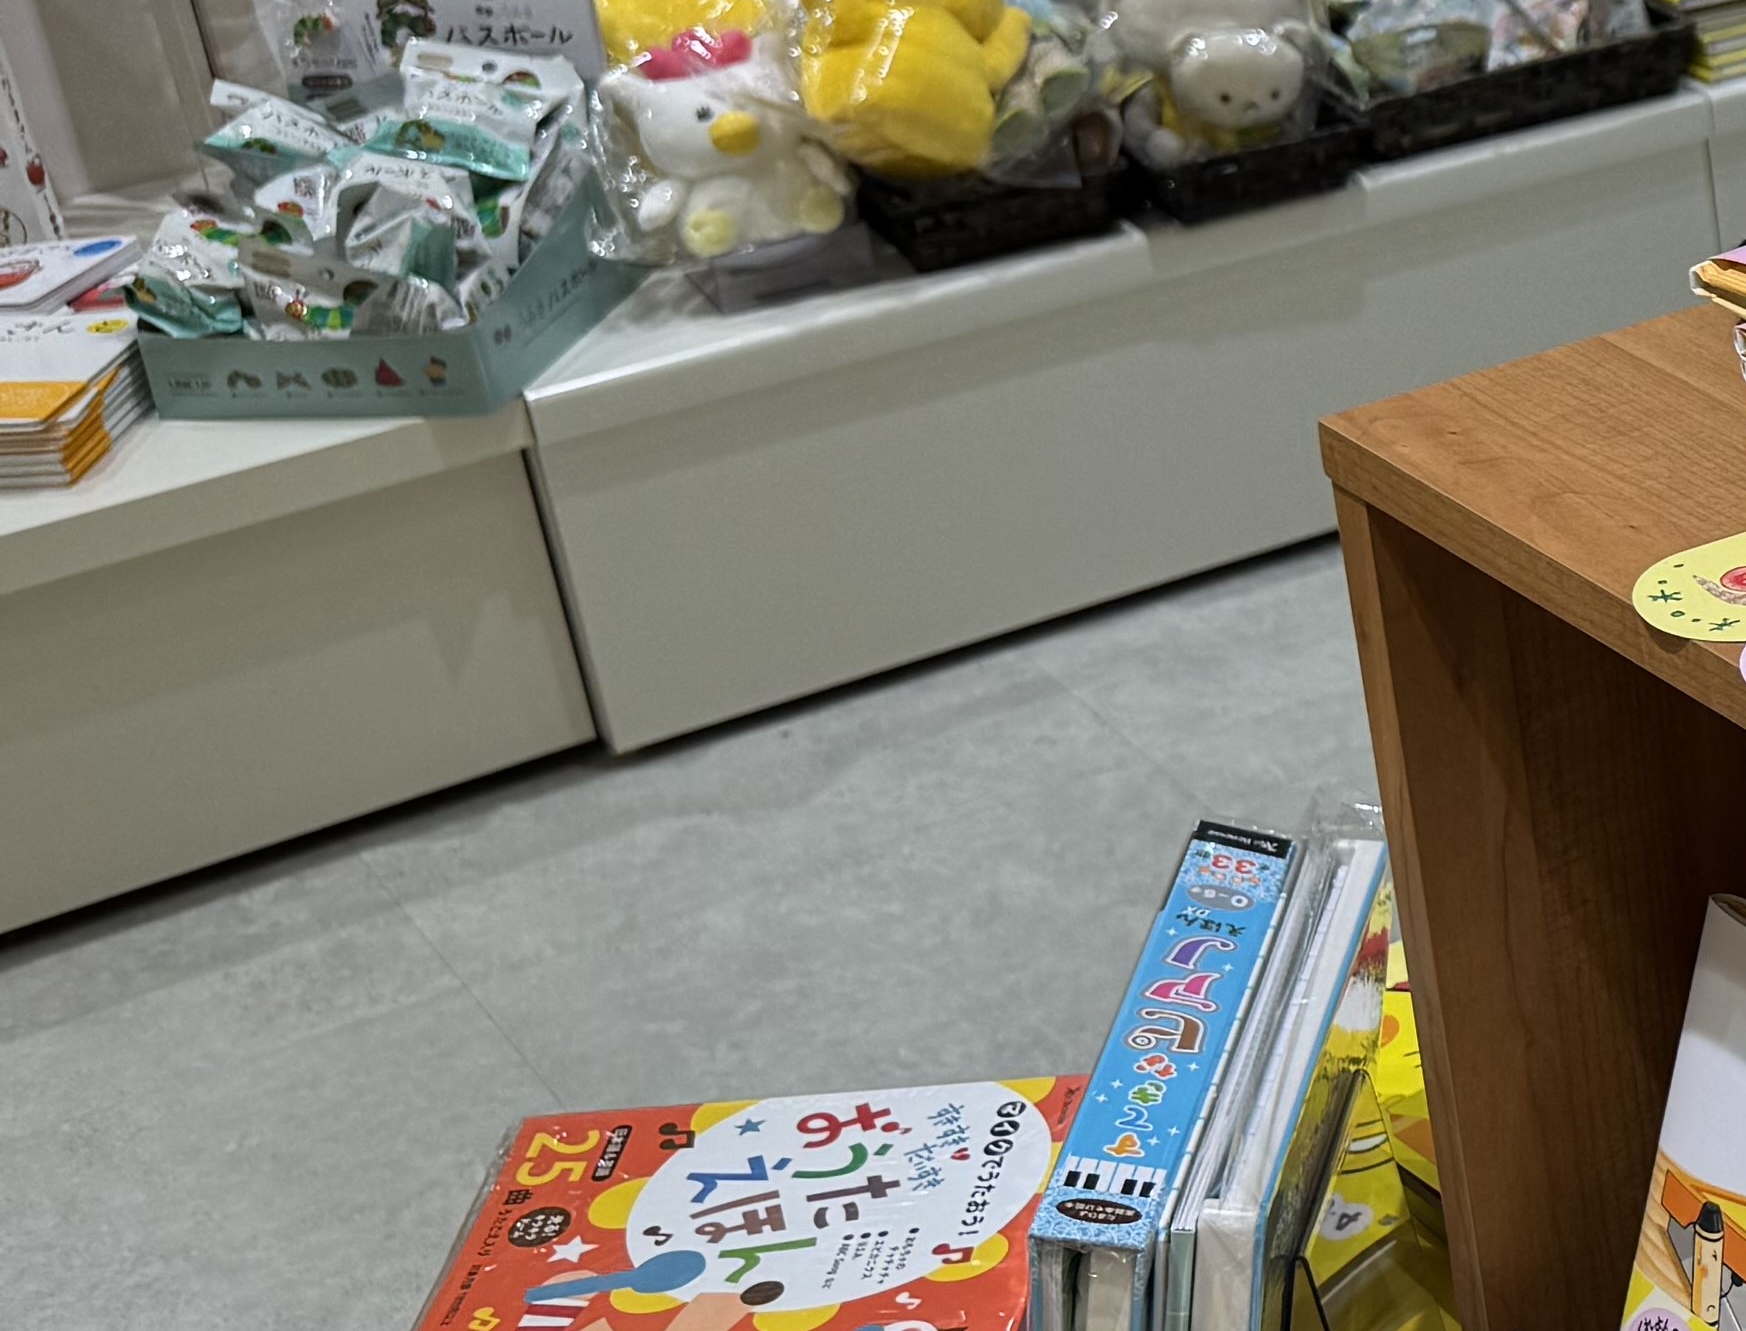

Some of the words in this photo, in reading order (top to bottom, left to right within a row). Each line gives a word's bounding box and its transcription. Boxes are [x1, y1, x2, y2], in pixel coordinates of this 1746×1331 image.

[1108, 936, 1238, 1158] すてきなピアノ
[505, 1189, 532, 1207] 曲
[686, 1155, 818, 1284] えほん
[792, 1103, 914, 1229] おうた
[961, 1100, 1028, 1236] マイクでうたおう!
